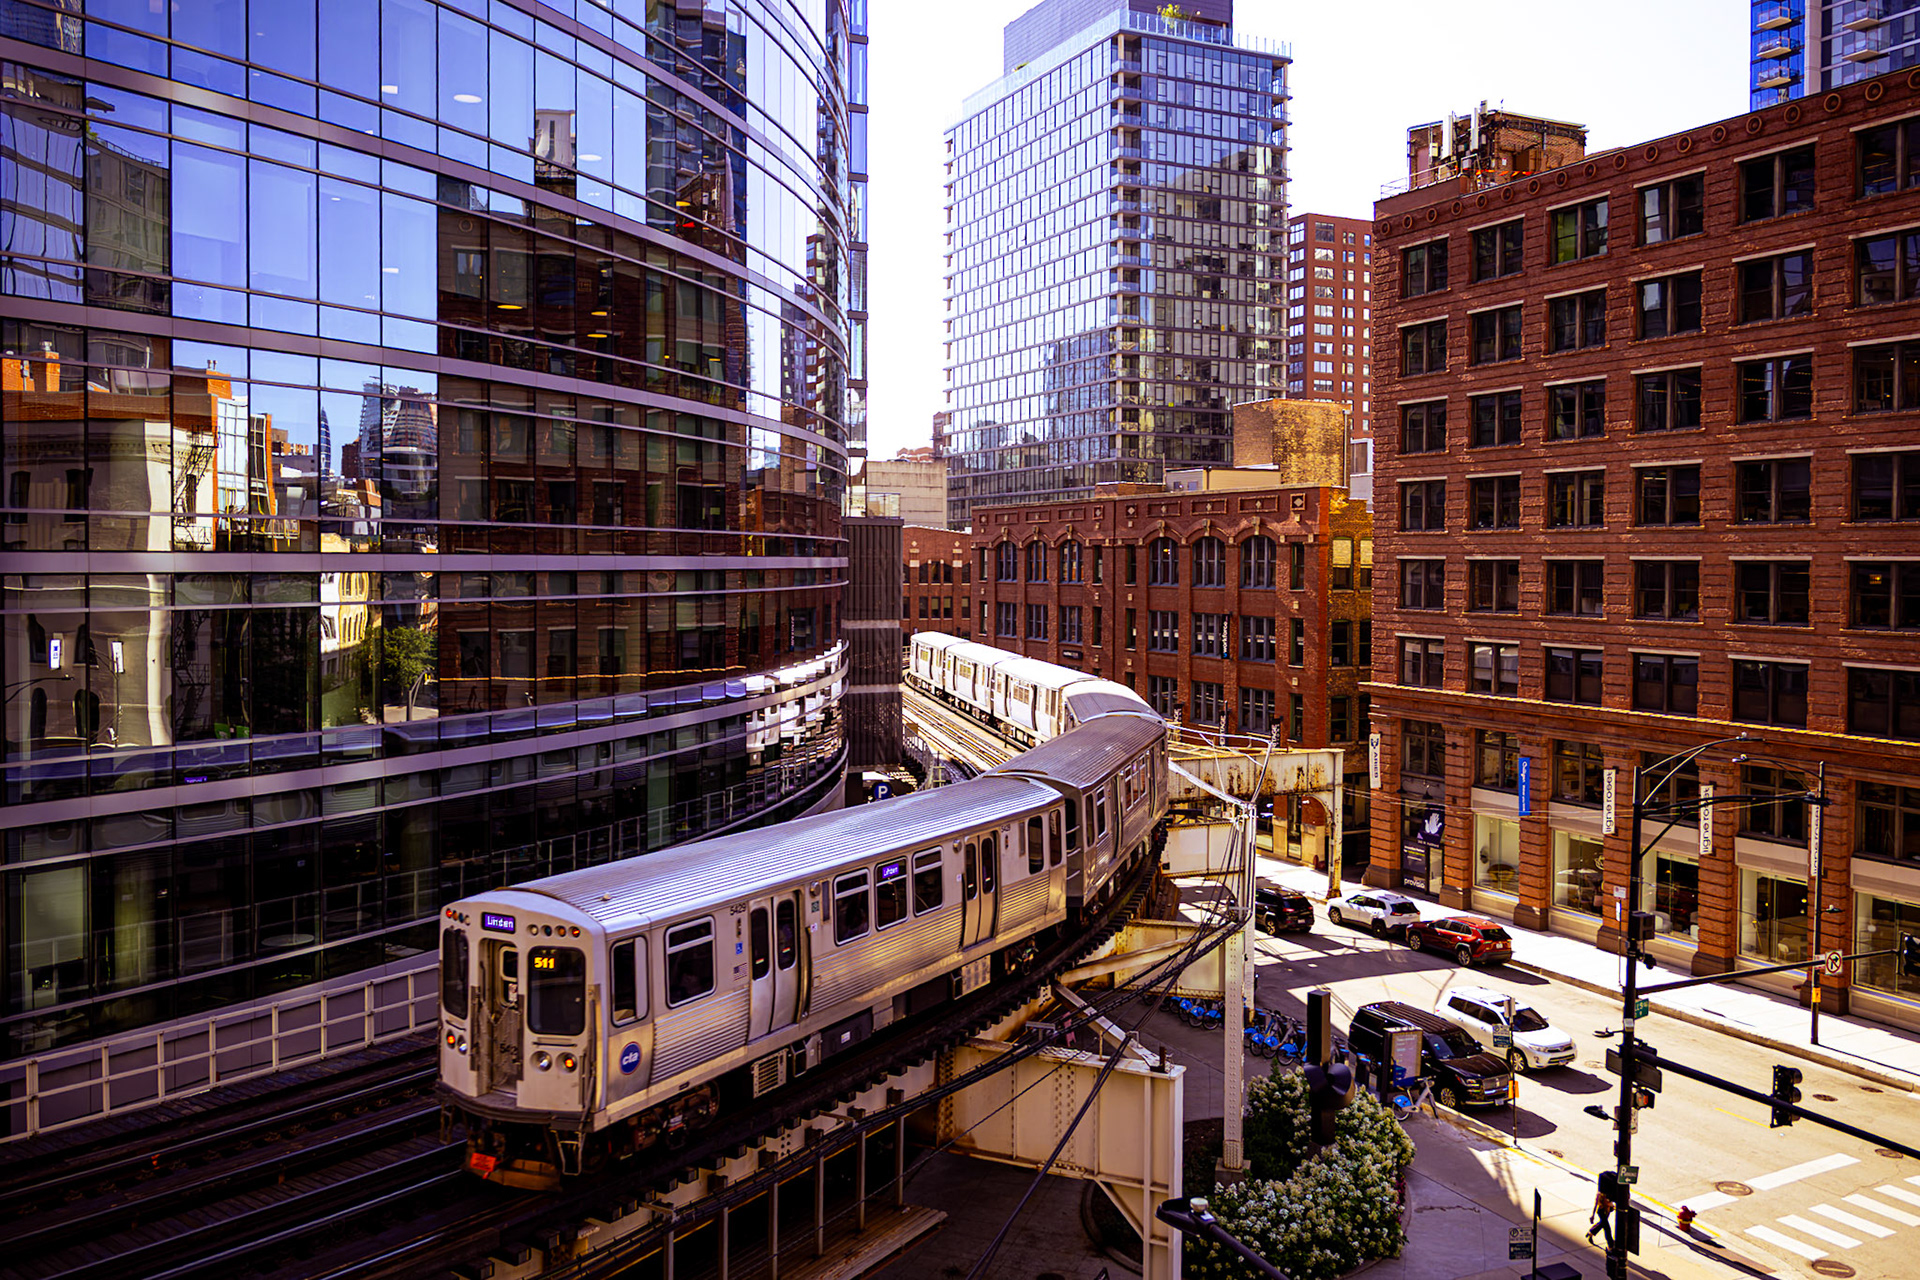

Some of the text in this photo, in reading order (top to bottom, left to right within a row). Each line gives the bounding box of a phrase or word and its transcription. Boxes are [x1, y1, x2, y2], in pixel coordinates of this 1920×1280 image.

[878, 785, 888, 799] P
[1605, 805, 1614, 832] ligne
[1703, 823, 1711, 852] ligne
[730, 902, 746, 916] 5429
[487, 915, 514, 928] Linden
[534, 957, 555, 969] 511
[622, 1052, 639, 1065] cta
